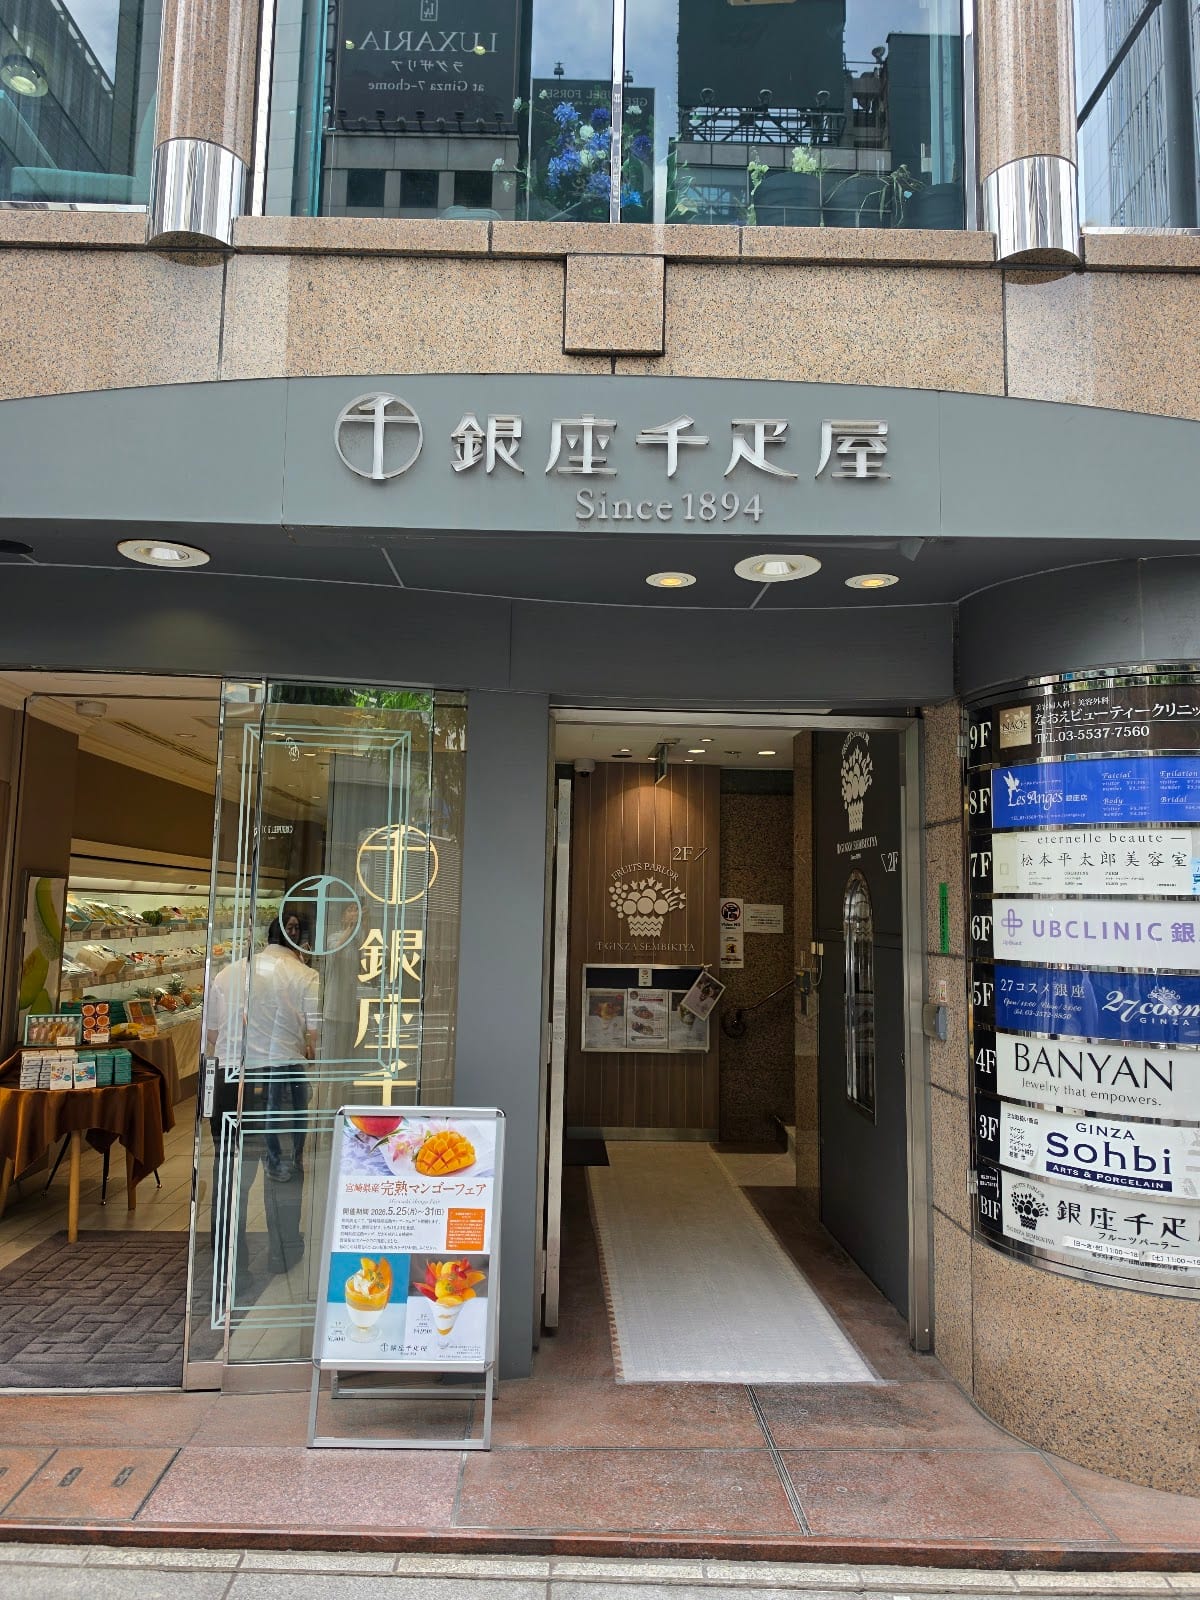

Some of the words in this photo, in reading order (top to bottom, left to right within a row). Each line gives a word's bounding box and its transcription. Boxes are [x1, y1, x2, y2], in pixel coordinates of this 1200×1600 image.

[451, 412, 892, 480] 銀座千疋屋
[576, 488, 673, 522] Since
[682, 490, 764, 523] 1894
[969, 721, 992, 750] 9F
[969, 787, 991, 815] 8F
[1027, 790, 1063, 811] Anges
[672, 846, 694, 861] 2F
[887, 851, 899, 872] 2F
[970, 851, 992, 878] 7F
[1021, 850, 1188, 867] 松本平太郎美容室
[611, 862, 643, 881] FRUITS
[644, 862, 680, 881] PARLOR
[971, 915, 993, 941] 6F
[1032, 919, 1163, 941] UBCLINIC
[973, 981, 994, 1007] 5F
[1000, 978, 1085, 998] 27コスメ銀座
[1139, 1016, 1190, 1027] GINZA
[975, 1047, 997, 1074] 4F
[1014, 1042, 1173, 1092] BANYAN
[1022, 1077, 1059, 1095] Jewelry
[1064, 1084, 1086, 1098] that
[1090, 1090, 1162, 1107] empowers.
[979, 1114, 999, 1142] 3F
[1075, 1121, 1135, 1141] GINZA
[1046, 1131, 1172, 1175] Sohbi
[1052, 1163, 1079, 1176] ARTS
[1096, 1172, 1165, 1189] PORCELAIN
[980, 1195, 1001, 1221] B1F
[1056, 1199, 1200, 1242] 銀座千疋
[1098, 1232, 1180, 1248] フルーツパーラー
